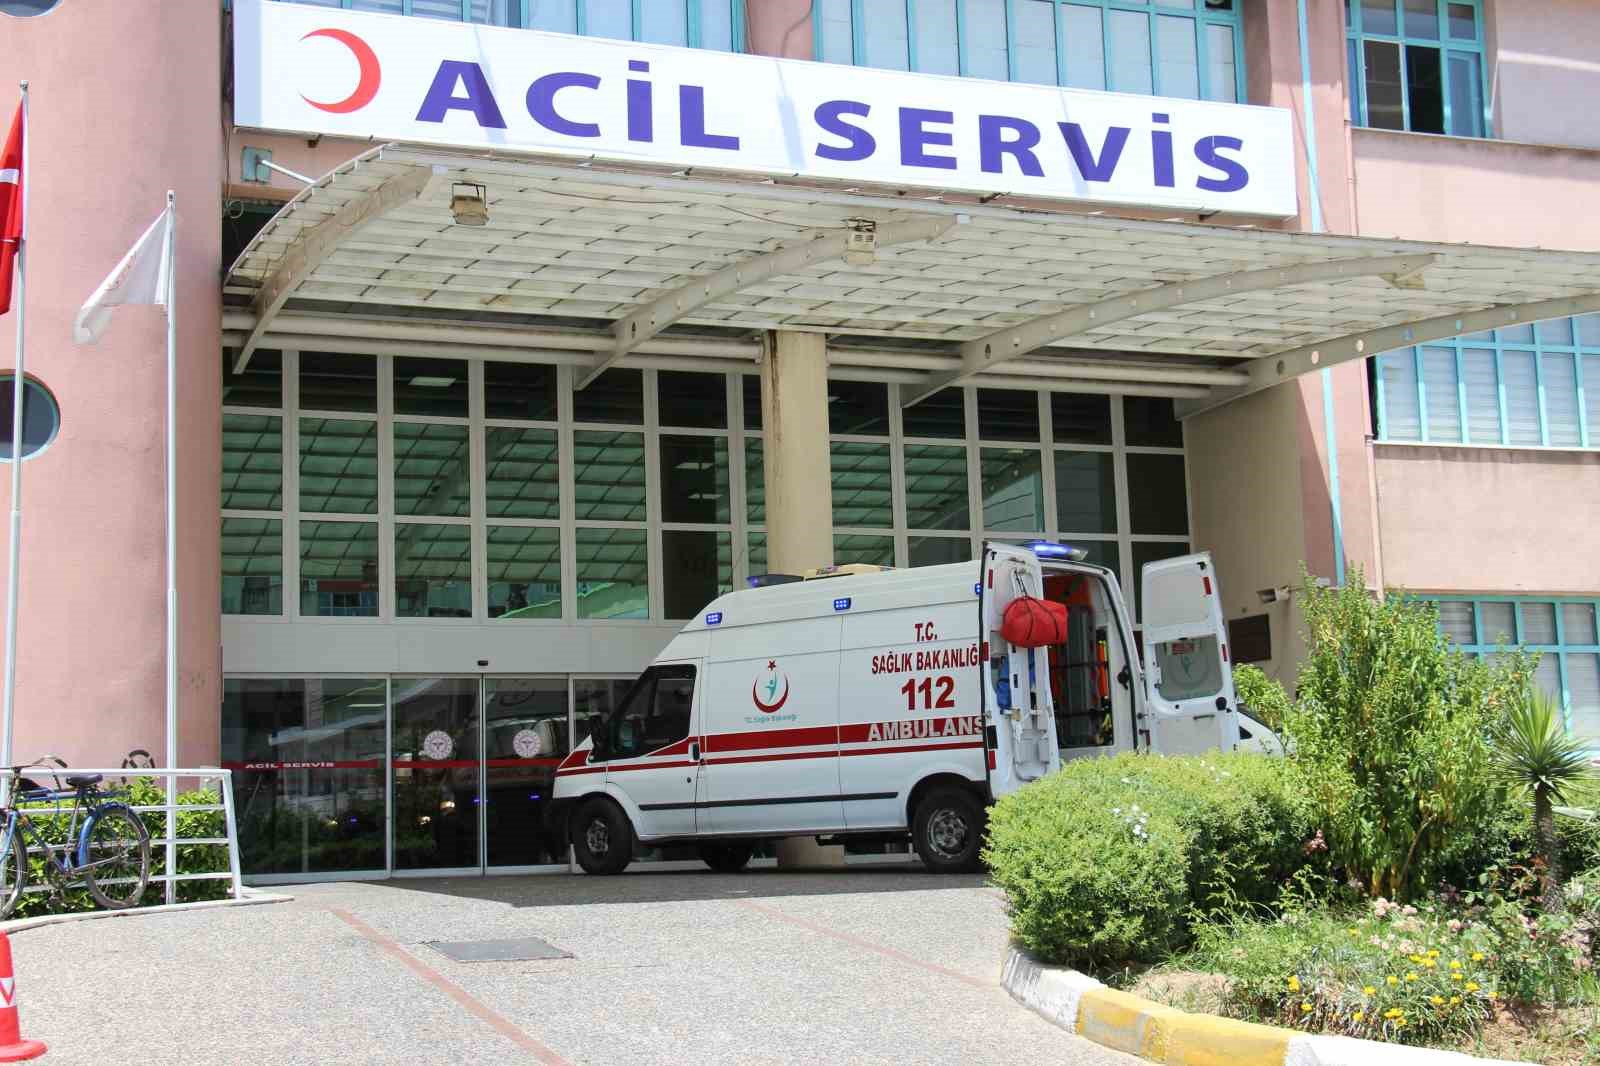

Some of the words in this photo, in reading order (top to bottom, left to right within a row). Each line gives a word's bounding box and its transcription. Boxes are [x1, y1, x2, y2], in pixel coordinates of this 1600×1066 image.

[415, 60, 740, 151] ACİL
[815, 101, 1249, 194] SERVİS
[914, 621, 938, 642] T.C.
[872, 651, 912, 674] SAĞLIK
[917, 643, 981, 671] BAKANLIĞ
[901, 675, 955, 711] 112
[868, 716, 983, 741] AMBULANS
